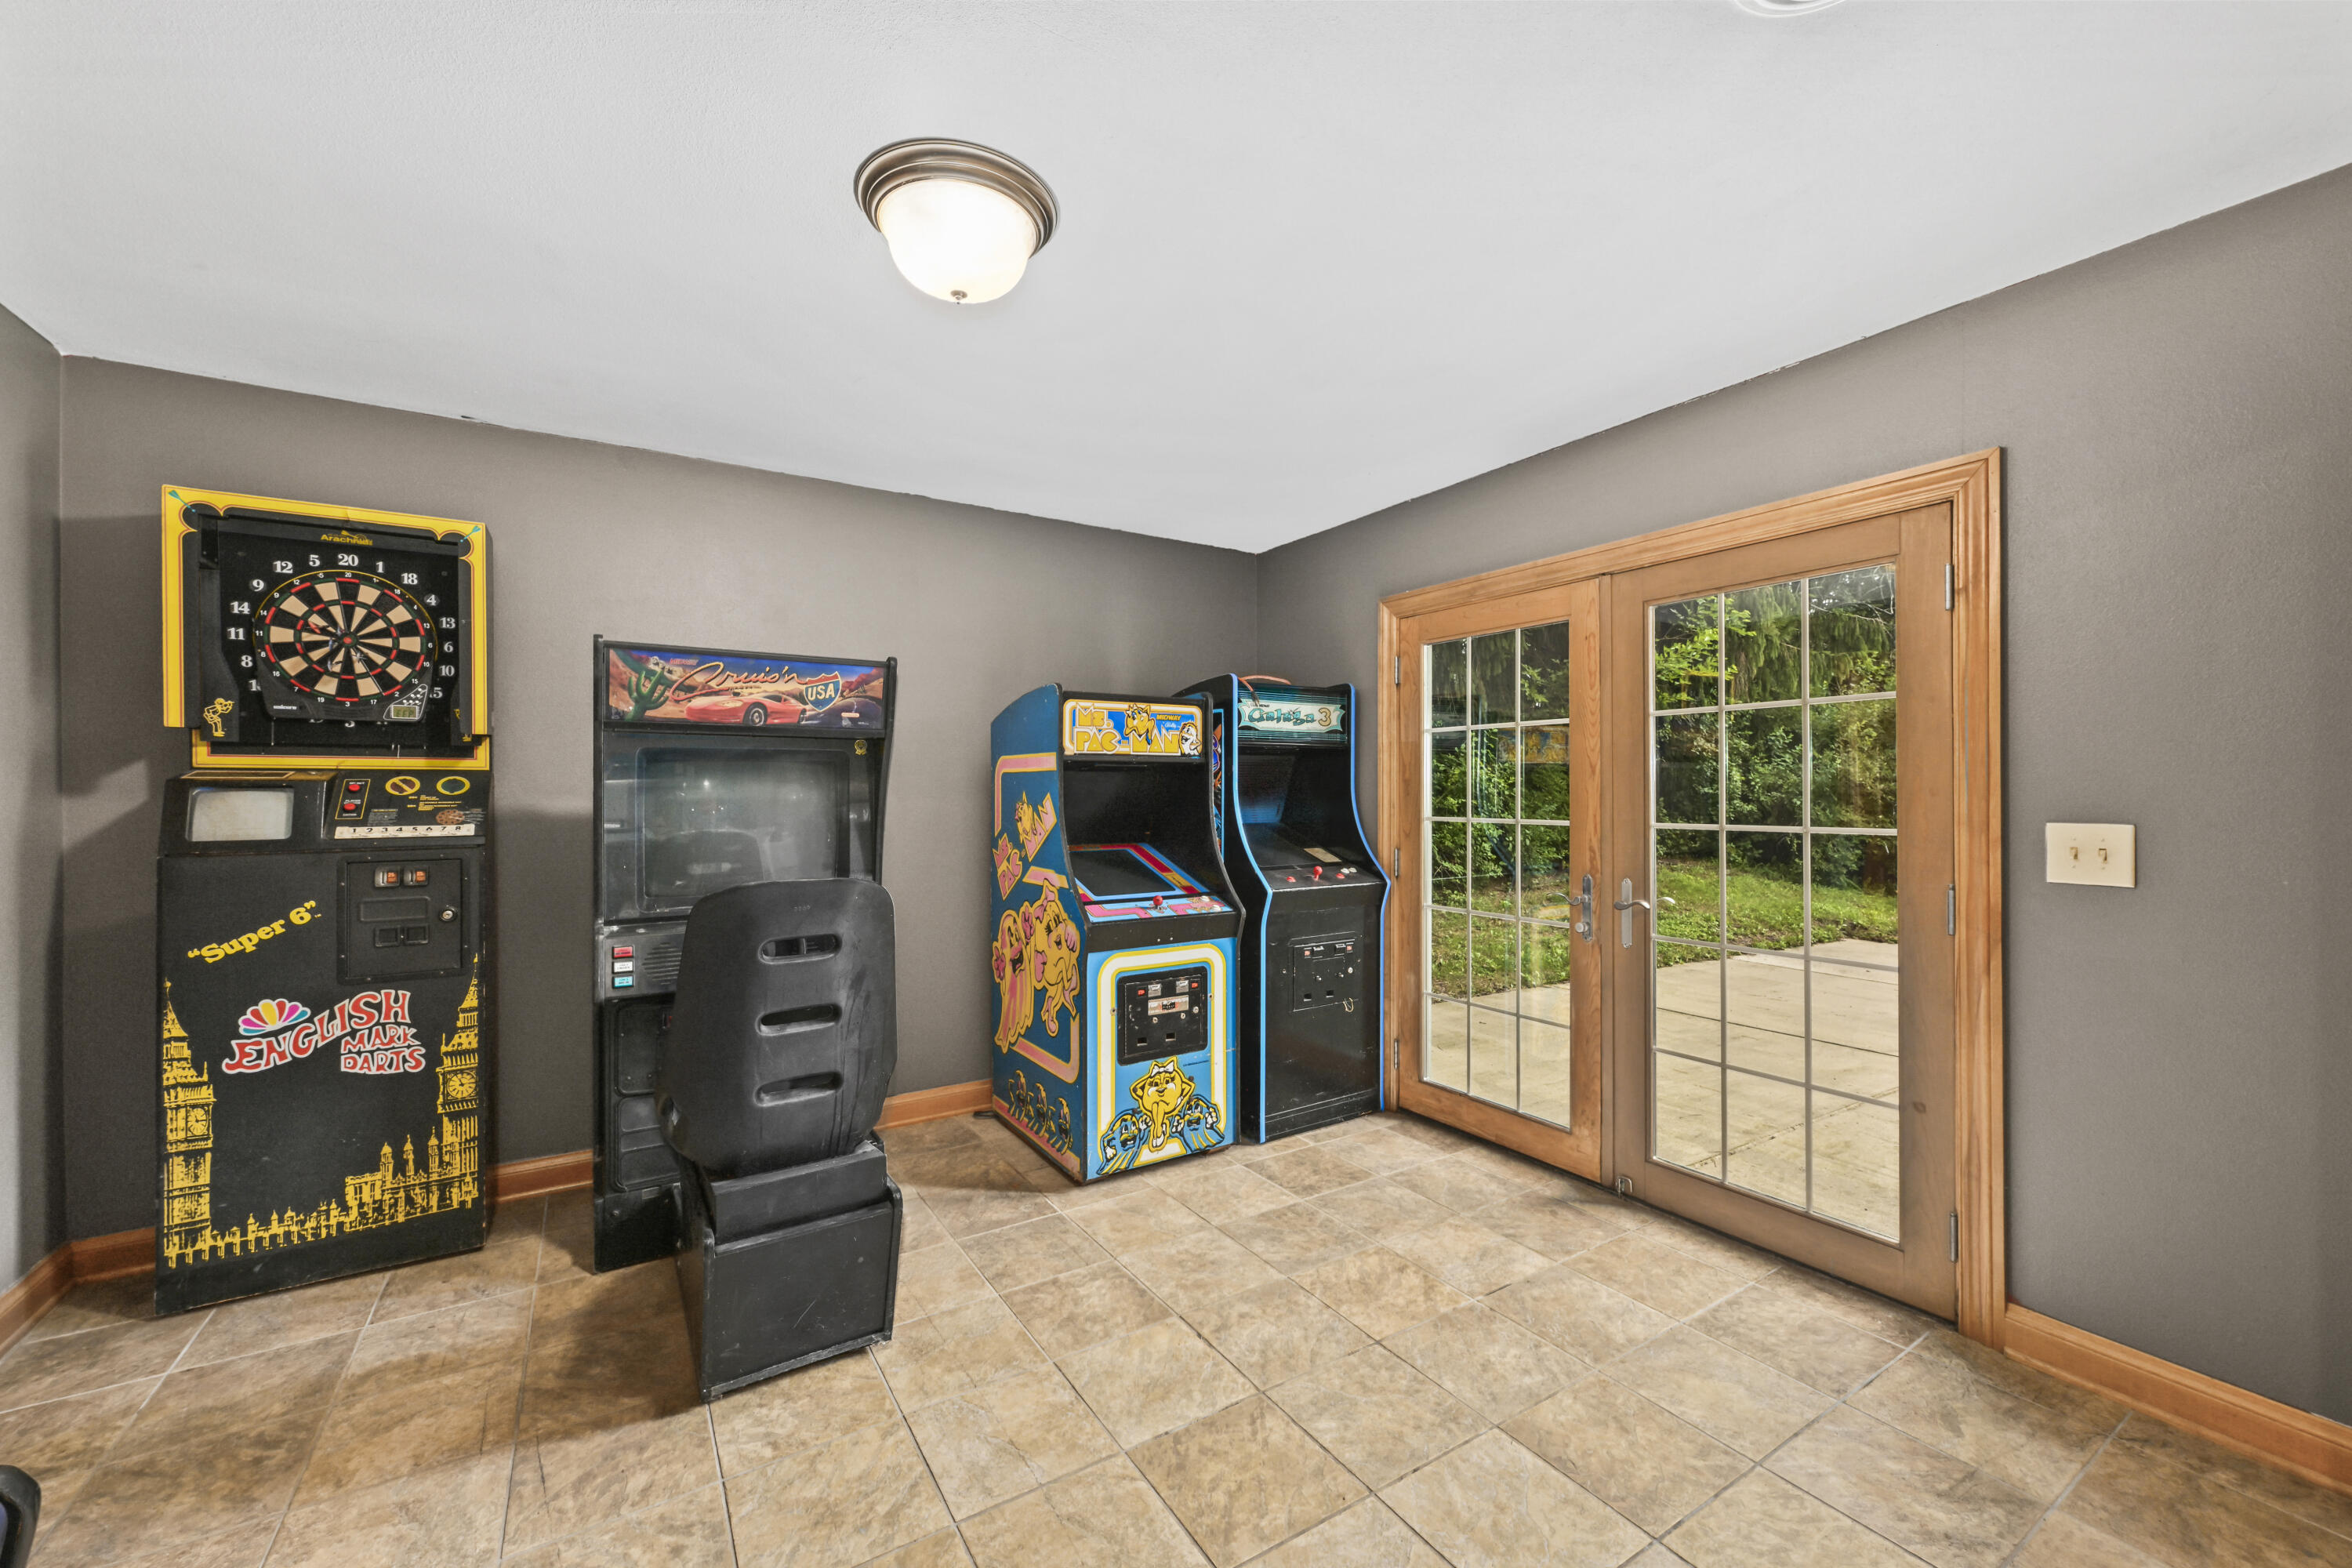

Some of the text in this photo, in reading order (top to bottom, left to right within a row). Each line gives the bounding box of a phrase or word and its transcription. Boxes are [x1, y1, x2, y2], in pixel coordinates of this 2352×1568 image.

[309, 554, 320, 567] 5
[338, 554, 358, 566] 20
[273, 561, 293, 573] 12
[376, 561, 384, 573] 1
[252, 579, 264, 591] 9
[401, 573, 418, 585] 18
[426, 594, 437, 606] 4
[230, 601, 250, 614] 14
[440, 617, 456, 629] 13
[227, 627, 245, 640] 11
[444, 641, 453, 652] 6
[241, 655, 253, 667] 8
[439, 665, 455, 677] 10
[670, 662, 835, 701] Cruis'n USA
[1248, 707, 1332, 727] Galaga 3
[1074, 728, 1181, 756] PAC-MAN
[187, 919, 286, 964] “Super
[222, 989, 411, 1074] ENGLISH
[340, 1024, 421, 1054] MARK
[340, 1046, 426, 1074] DARTS
